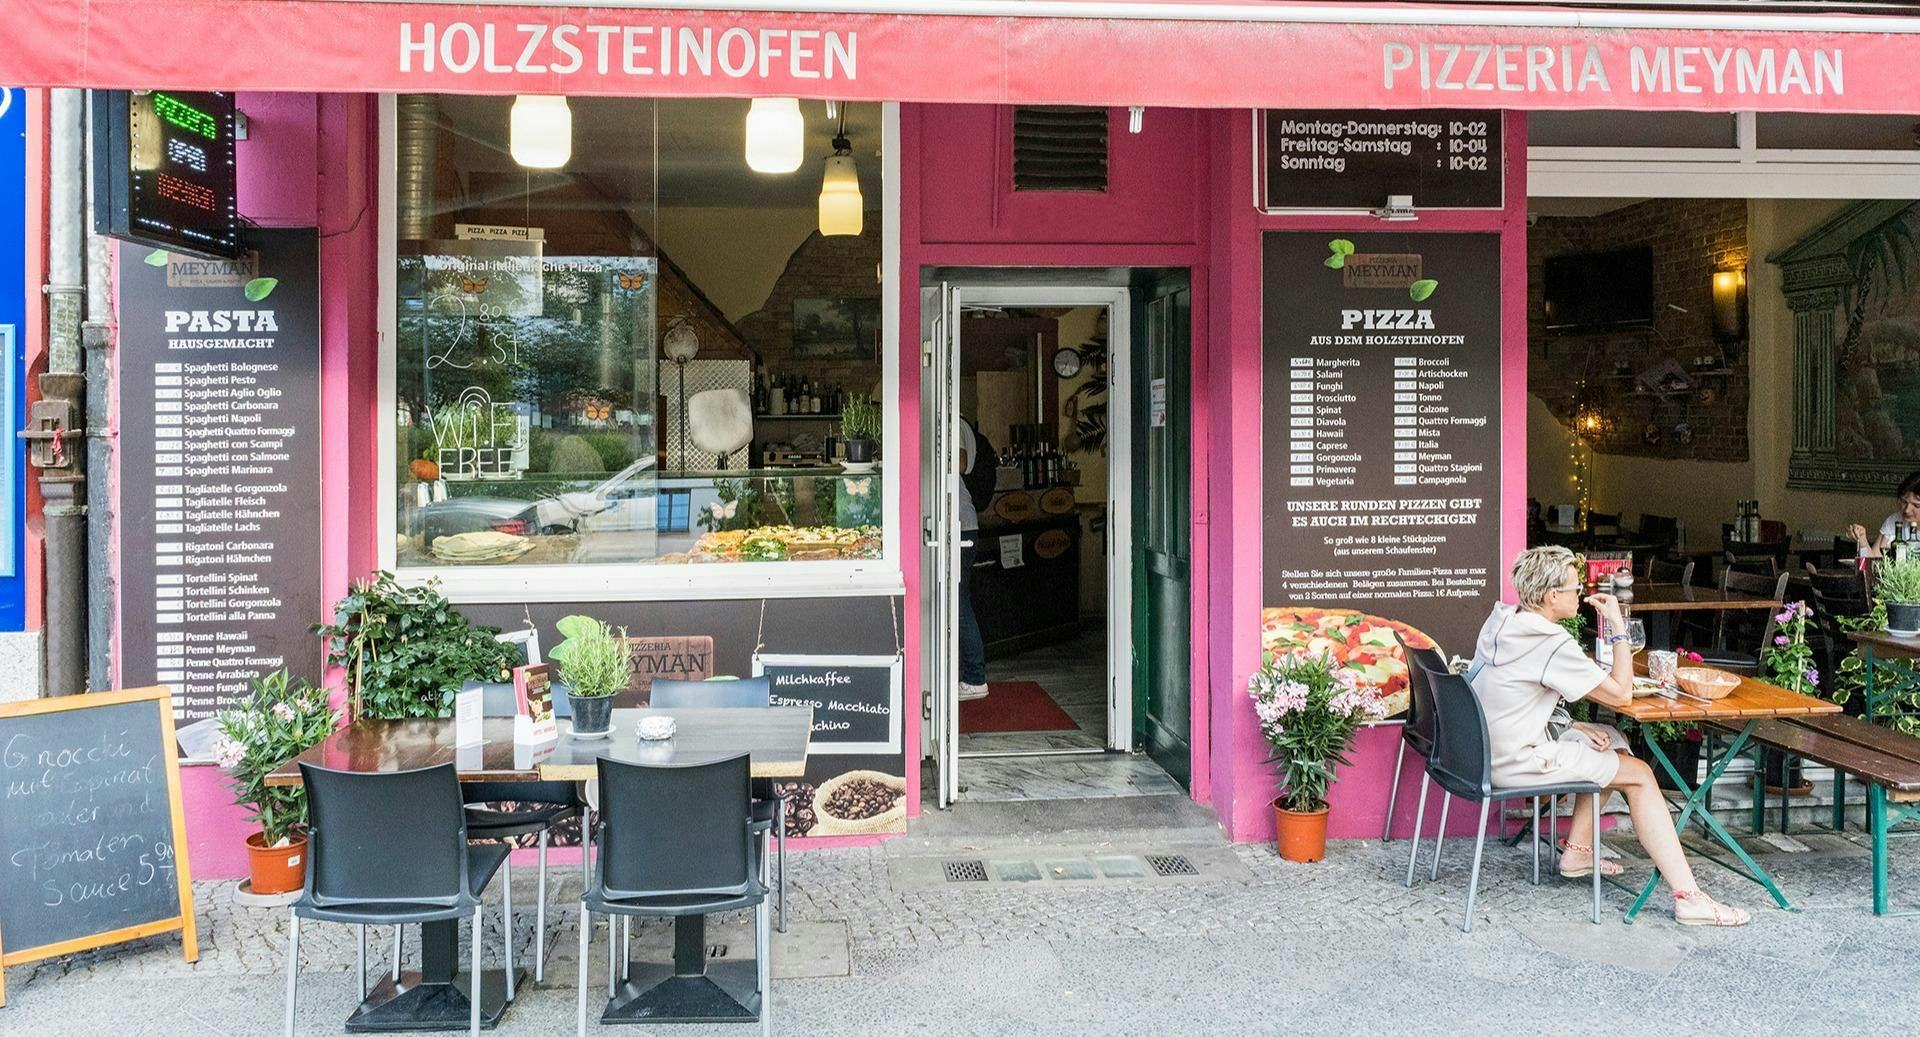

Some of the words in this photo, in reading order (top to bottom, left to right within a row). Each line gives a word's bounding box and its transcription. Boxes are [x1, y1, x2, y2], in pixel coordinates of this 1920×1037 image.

[400, 22, 857, 80] HOLZSTEINOFEN
[1384, 42, 1611, 92] PIZZERIA
[1630, 46, 1843, 95] MEYMAN
[1281, 120, 1442, 138] Montag-Donnerstag:
[1450, 122, 1486, 135] 10-02
[1281, 138, 1412, 156] Freitag-Samstag
[1450, 139, 1487, 153] 10-04
[1281, 155, 1345, 172] Sonntag
[1450, 157, 1487, 170] 10-02
[172, 262, 254, 276] MEYMAN
[569, 261, 602, 273] Pizza
[1348, 265, 1418, 278] MEYMAN
[165, 310, 278, 332] PASTA
[1342, 310, 1435, 329] PIZZA
[168, 339, 274, 349] HAUSGEMACHT
[1310, 336, 1331, 344] AUS
[1335, 336, 1362, 344] DEM
[1366, 336, 1464, 344] HOLZSTEINOFEN
[1317, 358, 1360, 368] Margherita
[1419, 357, 1449, 366] Broccoli
[184, 362, 228, 374] Spaghetti
[231, 362, 278, 374] Bolognese
[1317, 369, 1342, 378] Salami
[1419, 369, 1468, 377] Artischocken
[184, 375, 228, 387] Spaghetti
[231, 375, 256, 385] Pesto
[1317, 381, 1342, 392] Funghi
[1419, 380, 1444, 391] Napoli
[184, 388, 228, 399] Spaghetti
[230, 387, 255, 400] Aglio
[257, 388, 281, 399] Oglio
[1317, 393, 1356, 402] Prosciutto
[1419, 392, 1441, 401] Tonno
[184, 401, 228, 412] Spaghetti
[231, 400, 278, 411] Carbonara
[1317, 405, 1341, 416] Spinat
[1419, 404, 1448, 413] Calzone
[184, 414, 228, 425] Spaghetti
[231, 413, 261, 425] Napoli
[1317, 417, 1346, 425] Diavola
[1419, 416, 1448, 426] Quattro
[1451, 416, 1486, 426] Formaggi
[185, 427, 223, 438] Spaghetti
[225, 426, 256, 437] Quattro
[258, 426, 295, 438] Formaggi
[1317, 429, 1343, 437] Hawaii
[1419, 428, 1440, 437] Mista
[185, 440, 229, 451] Spaghetti
[231, 441, 248, 449] con
[250, 439, 283, 450] Scampi
[1316, 441, 1347, 451] Caprese
[1419, 439, 1438, 448] Italia
[185, 452, 229, 464] Spaghetti
[232, 454, 248, 462] con
[250, 451, 289, 461] Salmone
[1316, 452, 1361, 463] Gorgonzola
[1419, 452, 1451, 462] Meyman
[439, 447, 517, 480] FREE
[1317, 464, 1356, 473] Primavera
[1419, 463, 1448, 473] Quattro
[1451, 462, 1482, 473] Stagioni
[185, 465, 229, 477] Spaghetti
[232, 464, 273, 475] Marinara
[1316, 476, 1354, 487] Vegetaria
[1419, 474, 1466, 485] Campagnola
[185, 484, 232, 496] Tagliatelle
[235, 483, 287, 496] Gorgonzola
[185, 497, 232, 508] Tagliatelle
[235, 496, 266, 506] Fleisch
[1287, 501, 1338, 511] UNSERE
[1341, 499, 1396, 511] RUNDEN
[1400, 499, 1447, 510] PIZZEN
[1450, 498, 1482, 509] GIBT
[185, 510, 232, 521] Tagliatelle
[235, 509, 280, 519] Hähnchen
[1292, 516, 1307, 527] ES
[1310, 516, 1347, 527] AUCH
[1350, 515, 1368, 526] IM
[1371, 513, 1476, 525] RECHTECKIGEN
[185, 523, 233, 534] Tagliatelle
[235, 521, 260, 532] Lachs
[1324, 536, 1333, 544] So
[1336, 535, 1353, 546] groß
[1355, 536, 1369, 544] wie
[1371, 536, 1376, 544] 8
[1378, 535, 1400, 544] kleine
[1403, 534, 1446, 544] Stückpizzen
[185, 541, 224, 553] Rigatoni
[226, 540, 273, 551] Carbonara
[1334, 547, 1349, 556] (aus
[1386, 545, 1436, 556] Schaufenster)
[186, 554, 224, 566] Rigatoni
[227, 553, 271, 564] Hähnchen
[185, 573, 226, 583] Tortellini
[229, 572, 257, 585] Spinat
[1282, 569, 1309, 579] Stellen
[1311, 569, 1323, 578] Sie
[1325, 569, 1342, 578] sich
[1344, 570, 1370, 578] unsere
[1372, 569, 1396, 579] große
[1398, 568, 1452, 577] Familien-Pizza
[1454, 568, 1467, 576] aus
[1282, 582, 1287, 590] 4
[1290, 580, 1348, 590] verschiedenen
[1353, 579, 1384, 590] Belägen
[1431, 578, 1444, 587] Bei
[1446, 577, 1487, 588] Bestellung
[185, 586, 226, 595] Tortellini
[229, 585, 269, 595] Schinken
[1289, 592, 1304, 600] von
[1305, 591, 1311, 600] 2
[1311, 591, 1338, 600] Sorten
[1339, 590, 1352, 600] auf
[1352, 590, 1373, 599] einer
[1374, 590, 1412, 599] normalen
[185, 599, 226, 608] Tortellini
[229, 598, 281, 610] Gorgonzola
[186, 612, 226, 621] Tortellini
[229, 611, 245, 621] alla
[248, 611, 275, 620] Panna
[186, 632, 214, 641] Penne
[216, 630, 247, 641] Hawaii
[186, 645, 214, 654] Penne
[216, 644, 255, 656] Meyman
[186, 658, 212, 667] Penne
[212, 657, 245, 668] Quattro
[245, 655, 284, 668] Formaggi
[630, 652, 706, 673] YMAN
[186, 671, 214, 680] Penne
[216, 669, 260, 680] Arrabiata
[776, 671, 851, 687] Milchkaffee
[186, 684, 214, 693] Penne
[216, 682, 248, 694] Funghi
[186, 697, 214, 706] Penne
[769, 694, 823, 709] Espresso
[828, 700, 890, 715] Macchiato
[186, 710, 214, 719] Penne
[43, 873, 130, 906] Sauce
